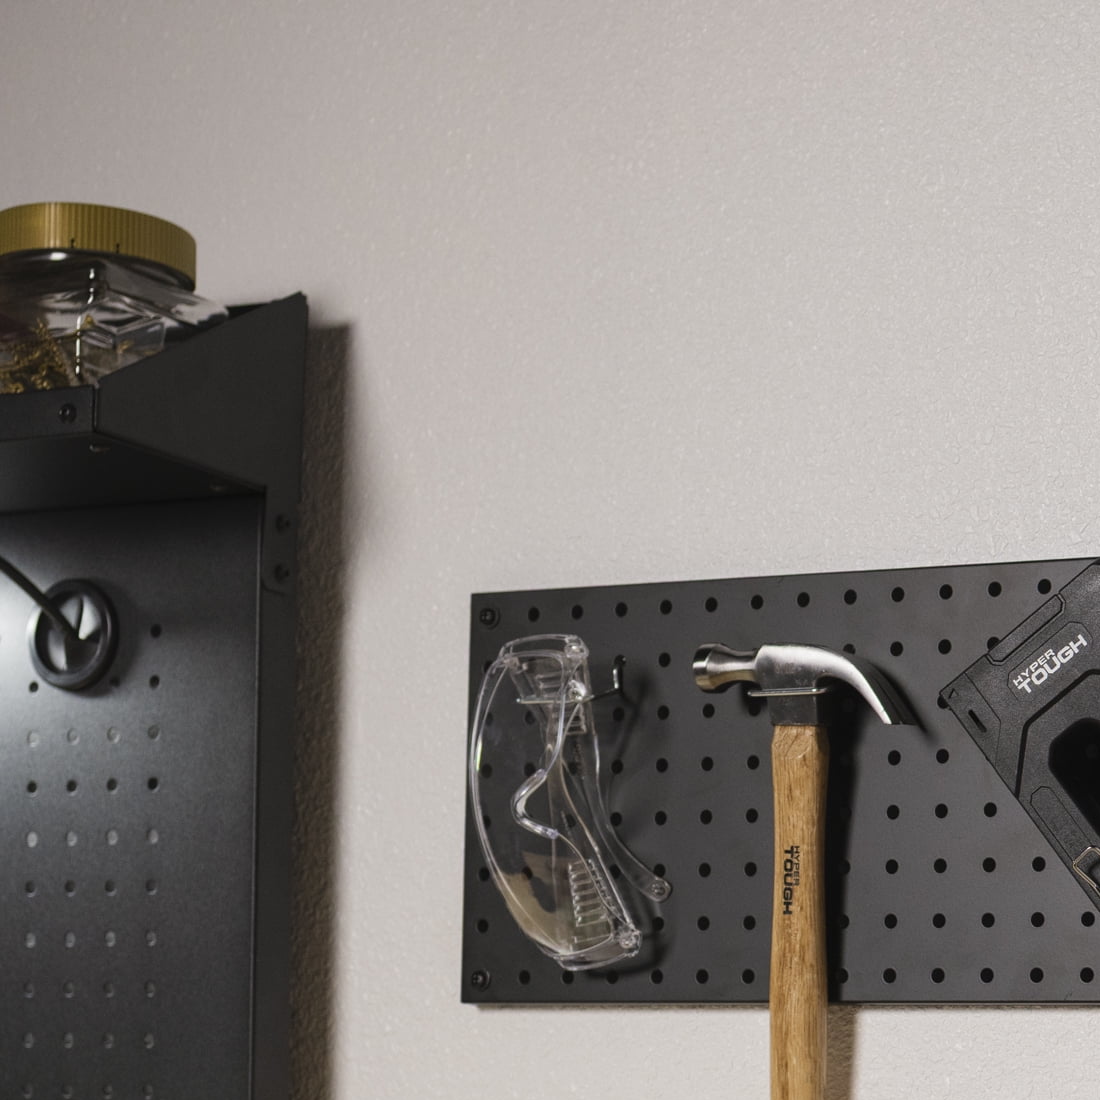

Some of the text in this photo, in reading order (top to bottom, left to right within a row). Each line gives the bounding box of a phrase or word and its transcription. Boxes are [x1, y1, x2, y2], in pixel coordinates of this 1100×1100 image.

[1012, 648, 1055, 686] HYPER
[1017, 634, 1088, 693] TOUGH
[782, 845, 794, 915] TOUGH
[792, 845, 801, 886] HYPER
